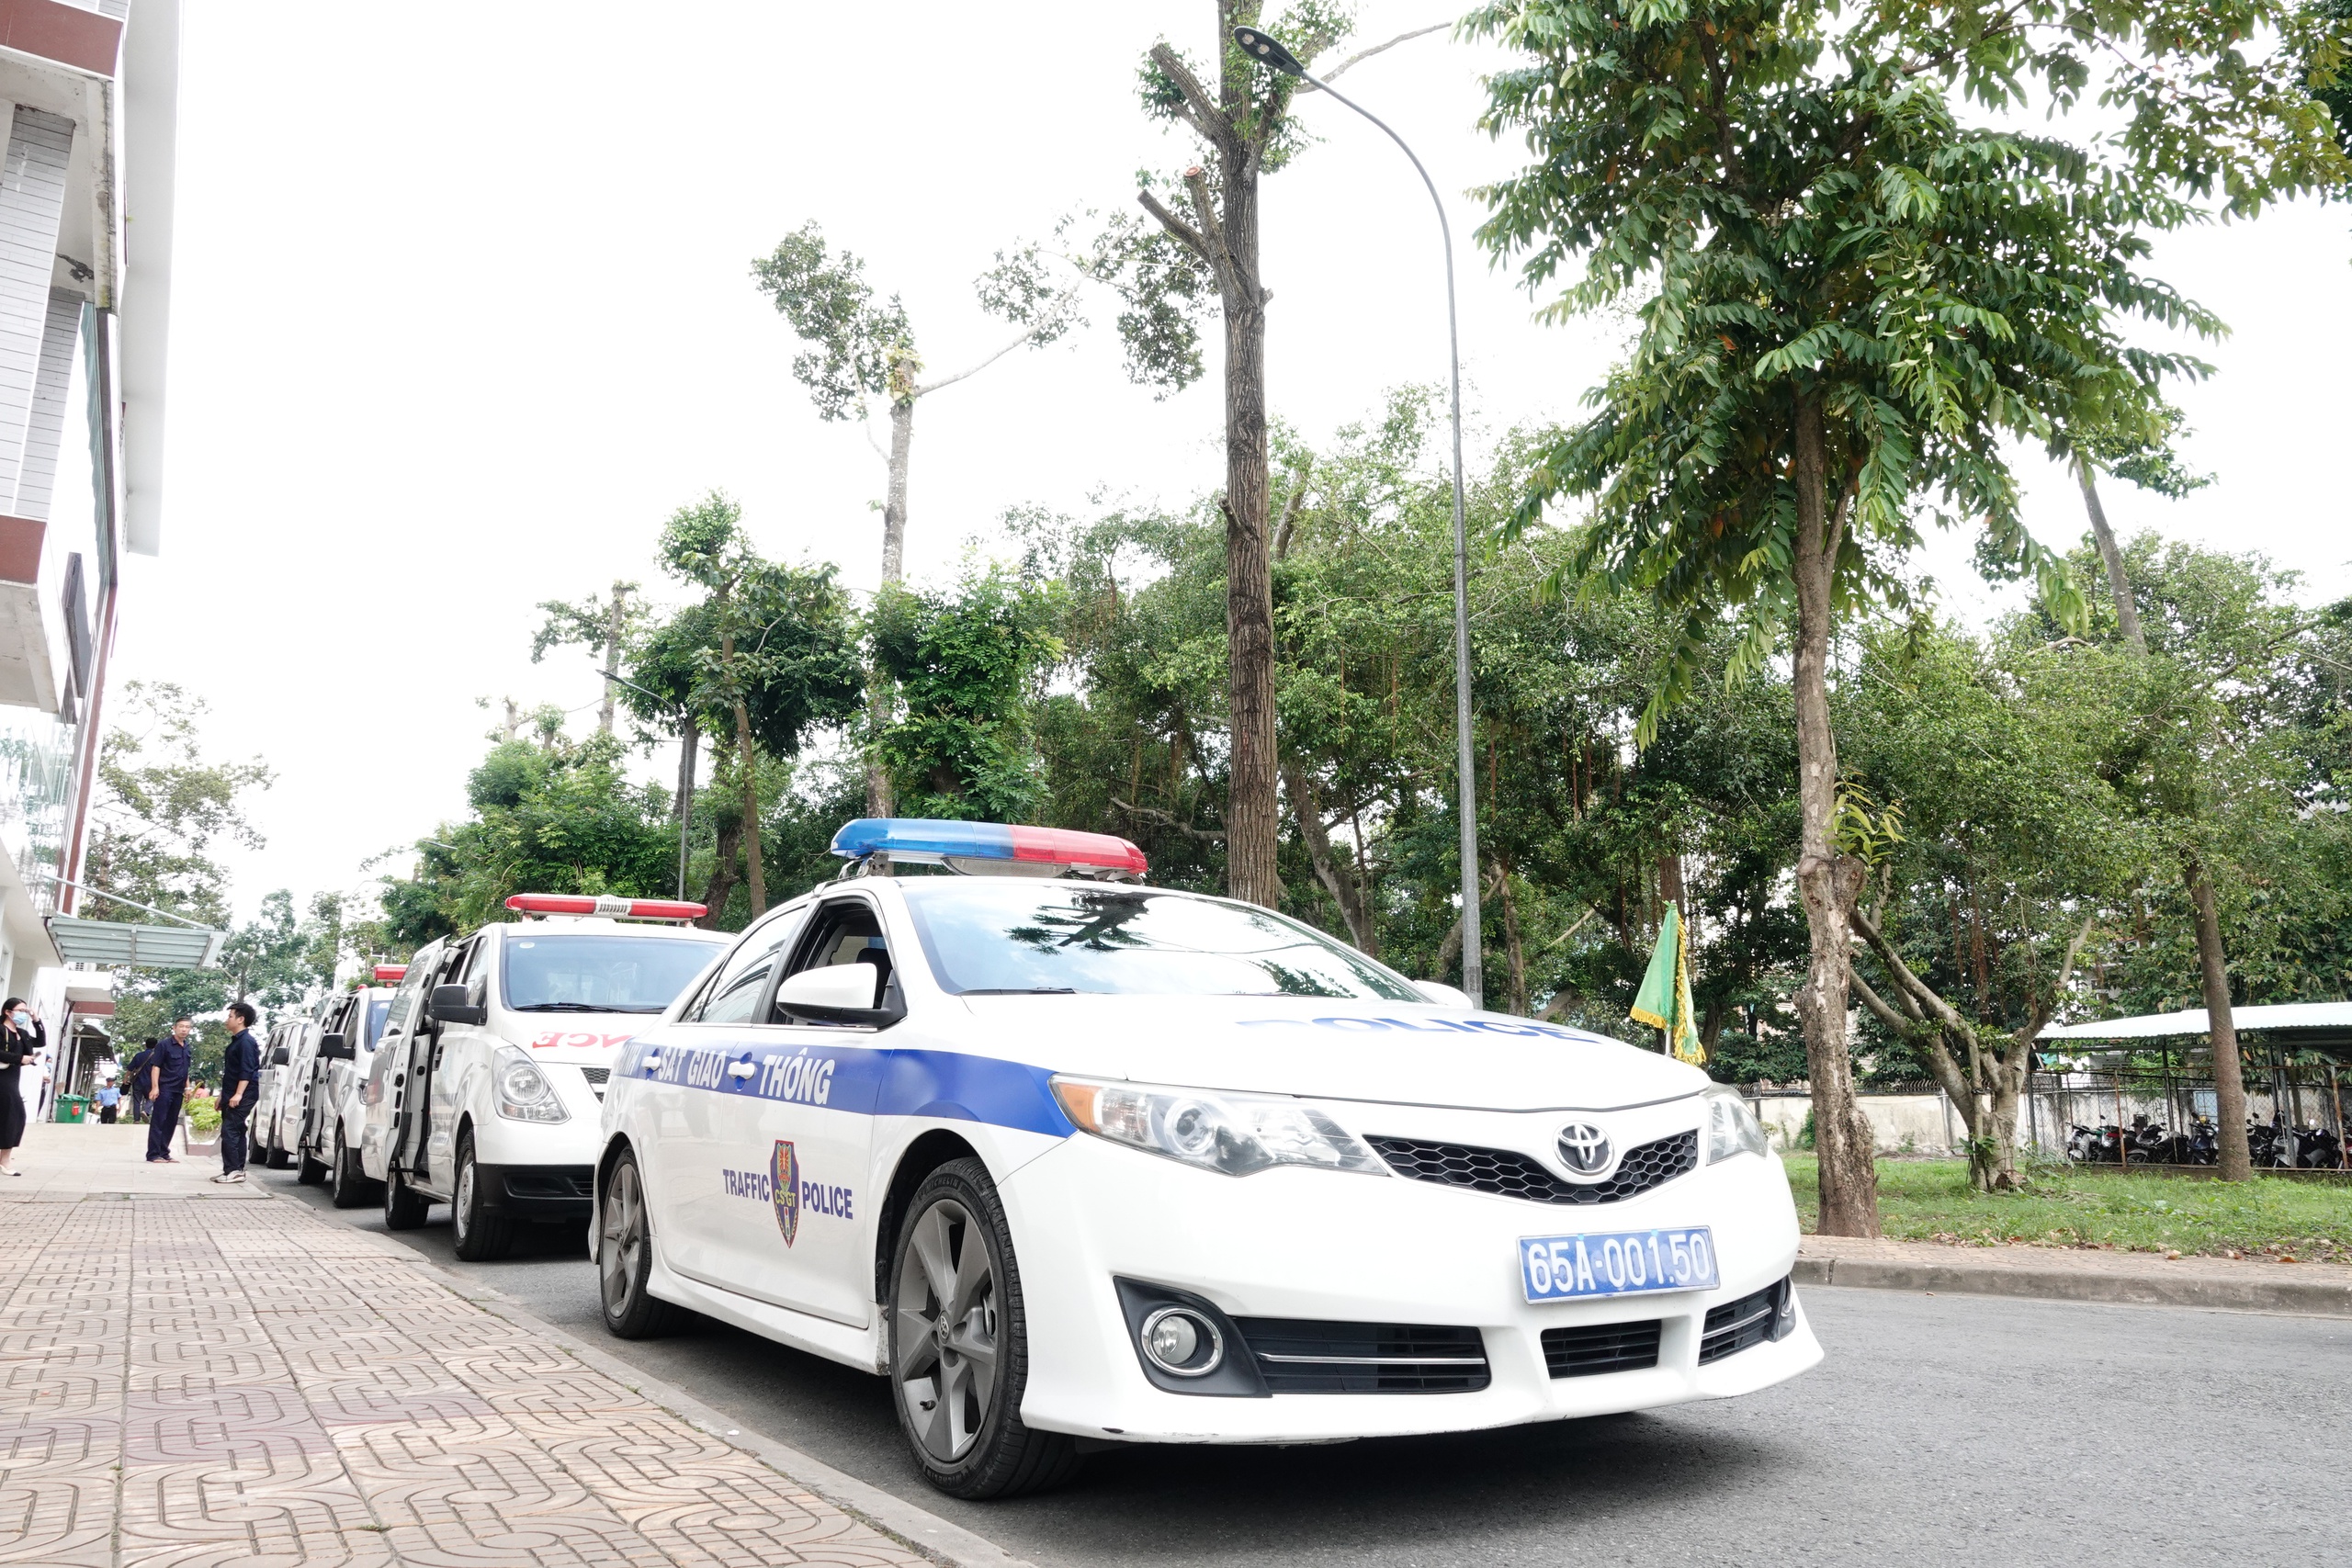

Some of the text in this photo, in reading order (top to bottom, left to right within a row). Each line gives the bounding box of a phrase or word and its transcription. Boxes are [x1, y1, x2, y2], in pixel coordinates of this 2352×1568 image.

[687, 1048, 727, 1089] GIAO
[758, 1048, 835, 1105] THÔNG
[722, 1168, 854, 1220] TRAFFIC POLICE
[1527, 1233, 1712, 1294] 65A-001.50
